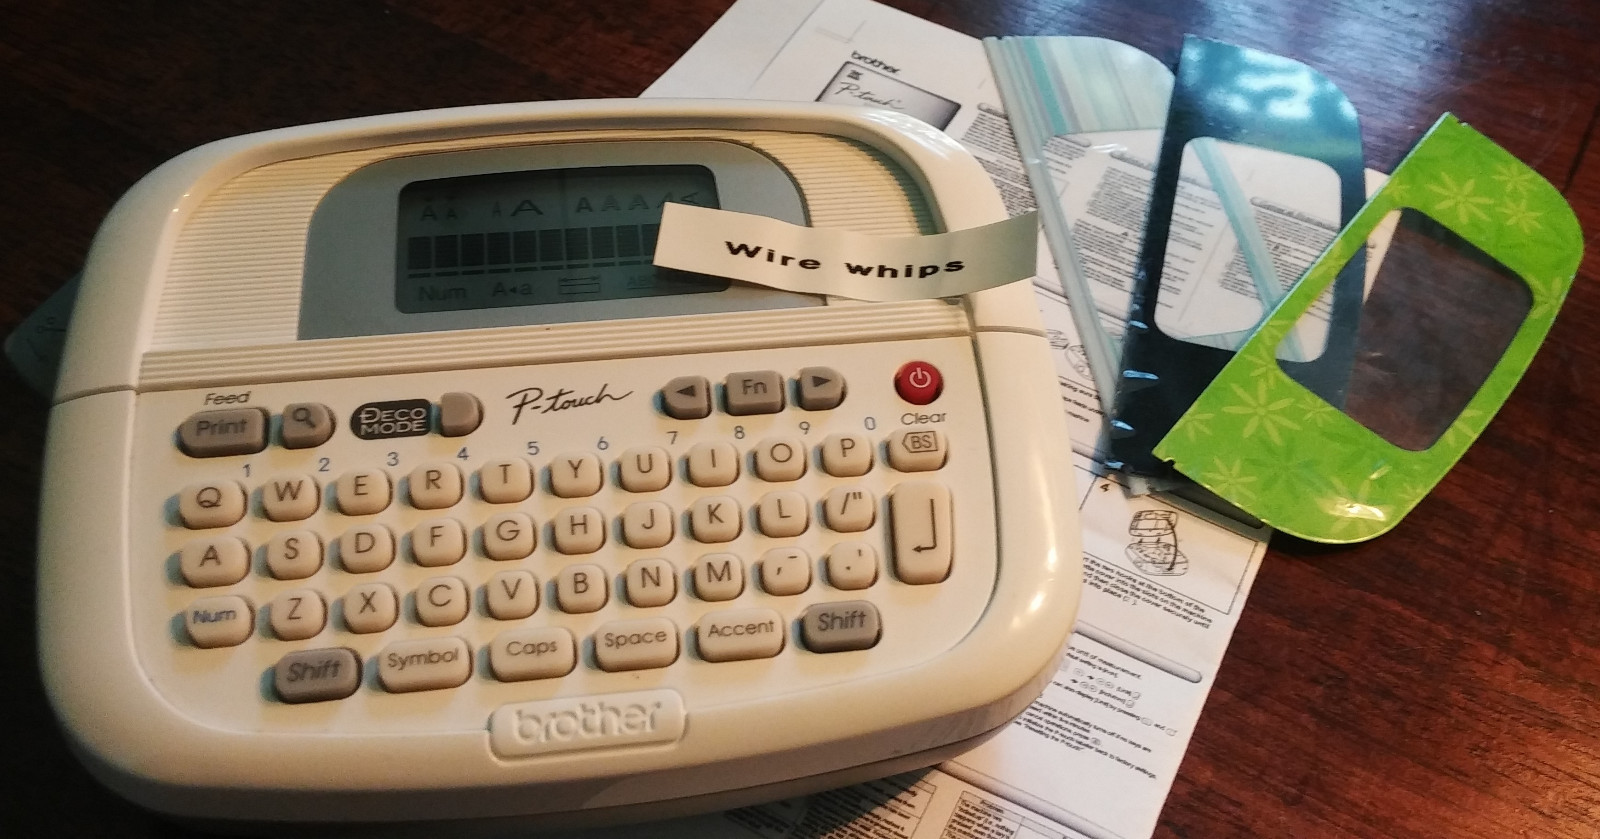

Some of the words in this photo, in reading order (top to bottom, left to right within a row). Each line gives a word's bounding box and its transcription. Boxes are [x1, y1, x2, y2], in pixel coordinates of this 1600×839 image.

[852, 50, 898, 73] brother
[725, 240, 821, 271] Wire
[847, 257, 966, 281] whips
[418, 285, 467, 302] Num
[204, 392, 251, 405] Feed
[742, 379, 767, 395] Fn
[360, 407, 427, 423] DECO
[505, 382, 634, 426] P-touch
[901, 411, 946, 425] Clear
[196, 419, 247, 436] Print
[361, 420, 427, 436] MODE
[243, 464, 250, 477] 1
[319, 458, 330, 472] 2
[387, 452, 399, 466] 3
[457, 447, 469, 460] 4
[527, 442, 540, 455] 5
[597, 437, 609, 450] 6
[666, 431, 678, 444] 7
[734, 425, 745, 439] 8
[800, 421, 810, 435] 9
[196, 487, 221, 508] Q
[274, 480, 303, 500] W
[354, 475, 368, 496] E
[426, 470, 441, 490] R
[499, 464, 512, 484] T
[568, 459, 583, 478] Y
[637, 454, 652, 474] U
[841, 438, 855, 457] P
[910, 434, 932, 451] BS
[200, 546, 221, 566] A
[285, 538, 299, 559] S
[355, 532, 375, 553] D
[430, 525, 444, 547] F
[496, 520, 520, 541] G
[570, 515, 587, 535] H
[642, 510, 654, 530] J
[707, 504, 724, 524] K
[778, 499, 791, 518] L
[193, 609, 236, 624] Num
[287, 598, 302, 620] Z
[359, 592, 376, 613] X
[429, 585, 452, 607] C
[502, 579, 522, 600] V
[573, 574, 588, 594] B
[641, 567, 661, 588] N
[707, 562, 731, 582] M
[287, 660, 340, 682] Shift
[388, 650, 459, 671] Symbol
[507, 640, 557, 659] Caps
[605, 629, 667, 650] Space
[708, 619, 774, 638] Accent
[818, 610, 866, 631] Shift
[512, 702, 664, 744] brother
